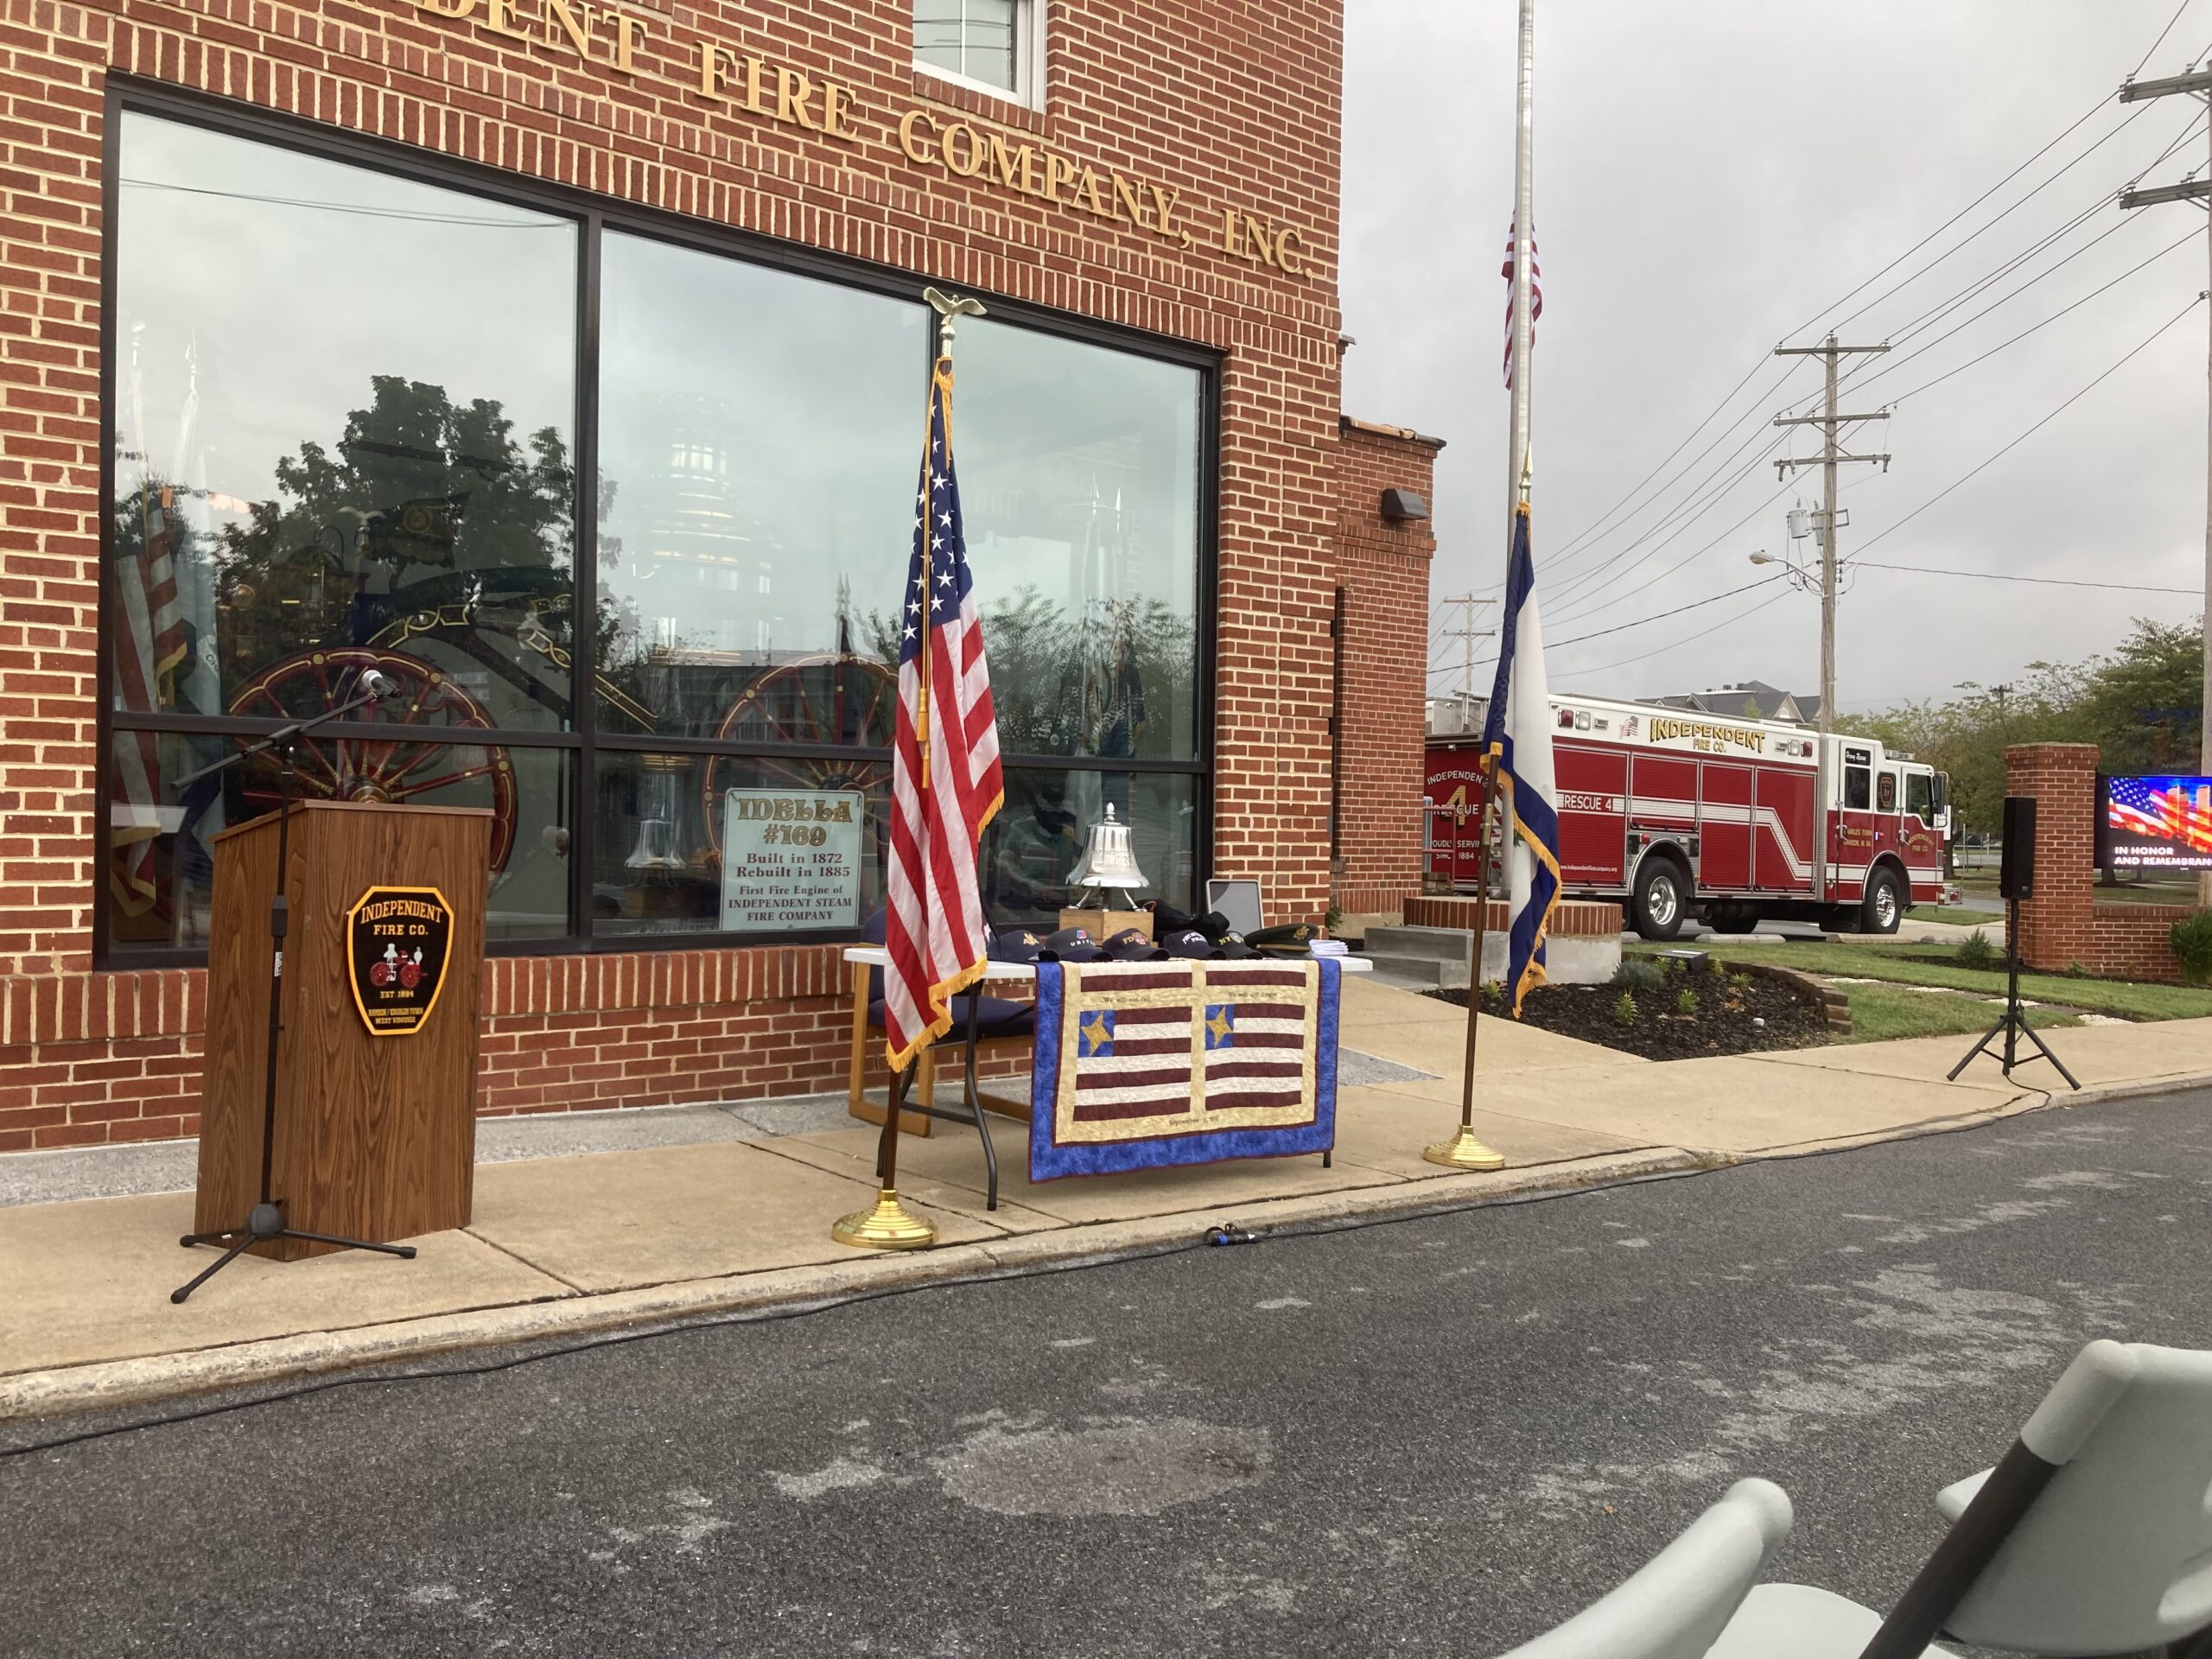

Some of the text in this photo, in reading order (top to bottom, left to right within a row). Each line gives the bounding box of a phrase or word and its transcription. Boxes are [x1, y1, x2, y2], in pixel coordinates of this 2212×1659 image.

[695, 40, 858, 143] FIRE
[897, 111, 1192, 249] COMPANY,
[1220, 207, 1313, 277] INC.
[1649, 717, 1765, 753] INDEPENDENT
[1693, 738, 1726, 753] FIRE CO.
[1427, 770, 1486, 785] INDEPENDEN
[1446, 785, 1466, 826] 4
[1564, 794, 1612, 811] RESCUE 4
[737, 798, 853, 823] IDELLA
[763, 823, 827, 847] #169
[2114, 846, 2175, 855] IN HONOR
[747, 853, 843, 864] Built in 1872
[2113, 856, 2212, 867] AND REMEMBRAN
[736, 867, 850, 878] Rebuilt in 1885
[740, 884, 843, 897] First Fire Engine of
[728, 897, 852, 909] INDEPENDENT STEAM
[360, 899, 443, 925] INDEPENDENT
[747, 911, 834, 921] FIRE COMPANY
[373, 925, 429, 936] FIRE CO.
[380, 990, 395, 999] EST
[1169, 1118, 1199, 1127] September
